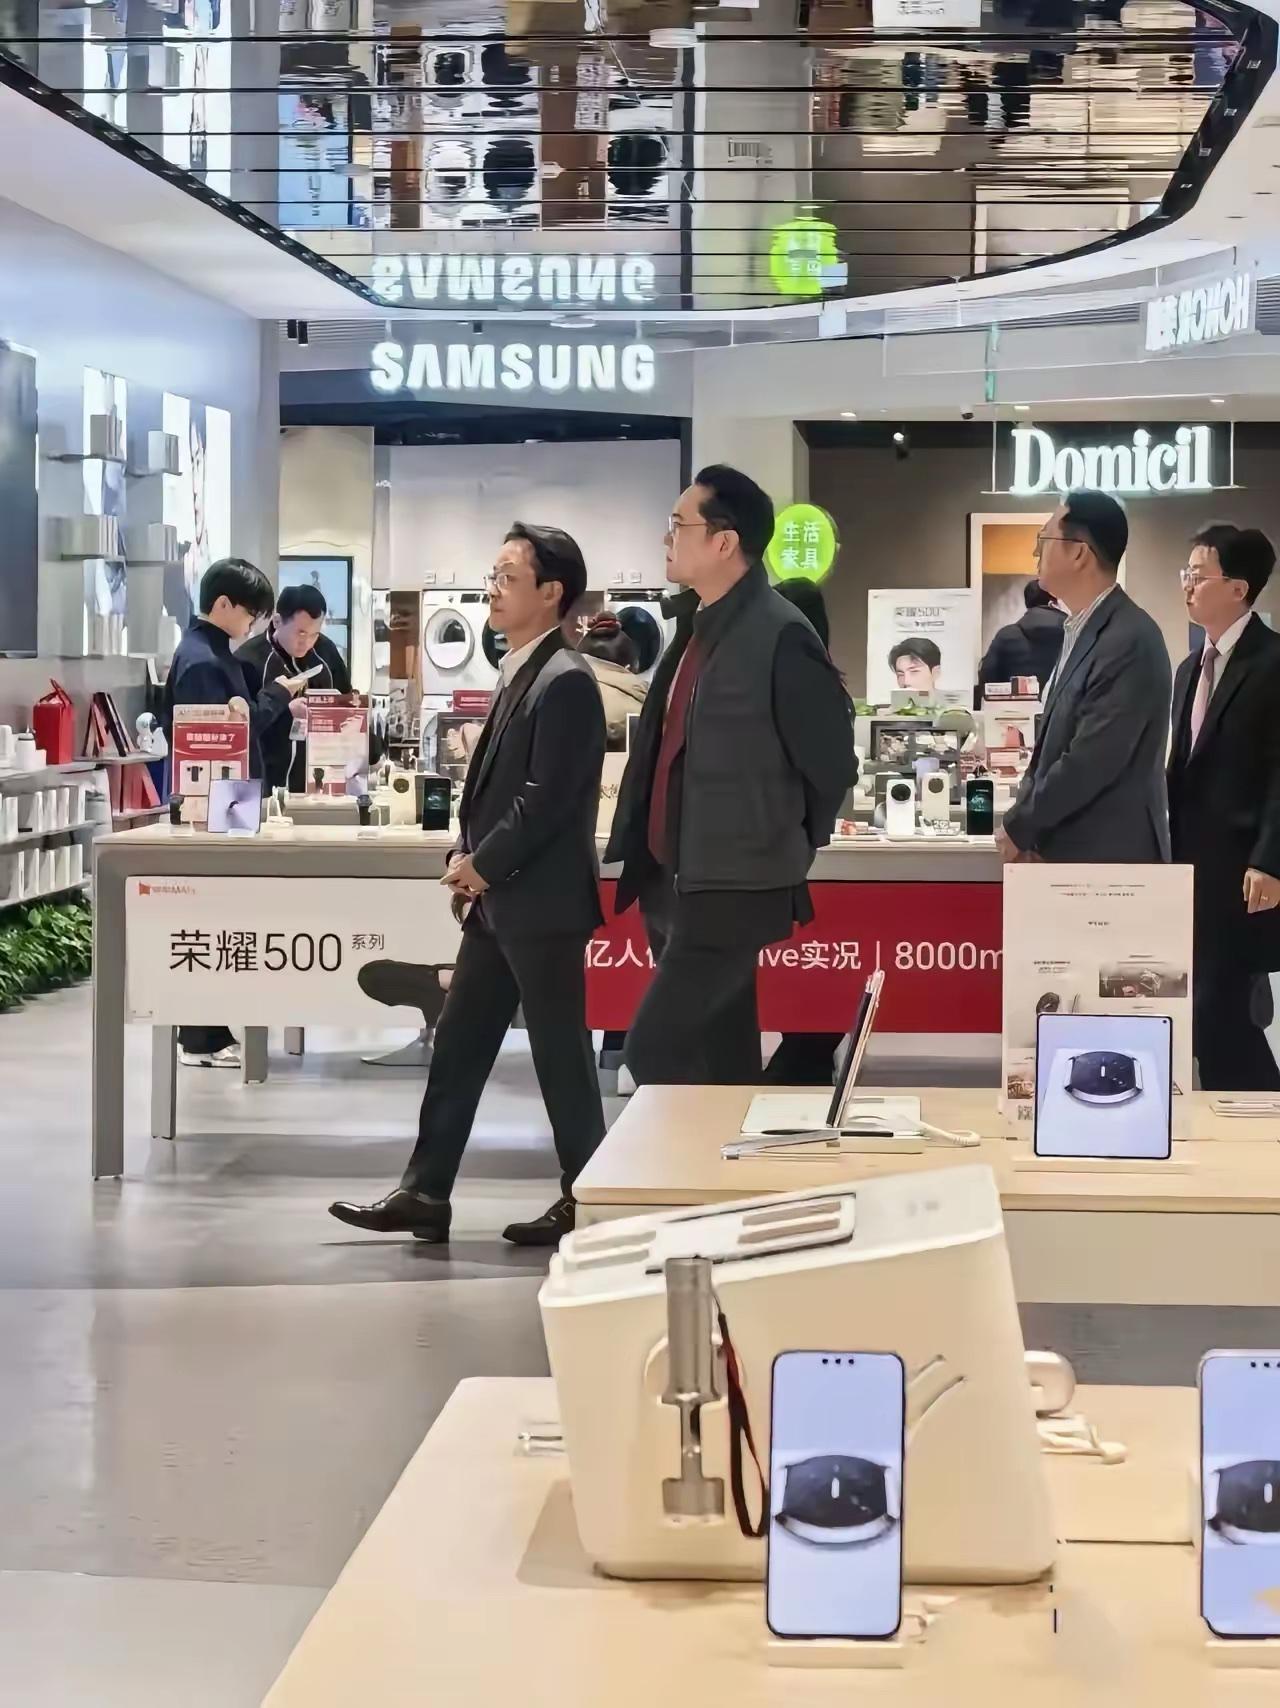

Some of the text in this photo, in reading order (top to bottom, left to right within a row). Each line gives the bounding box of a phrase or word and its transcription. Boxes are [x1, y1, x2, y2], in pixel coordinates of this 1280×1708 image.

[370, 342, 656, 393] SAMSUNG
[1008, 425, 1214, 494] Domicil
[782, 521, 821, 544] 生活
[169, 929, 385, 973] 荣耀500 系列
